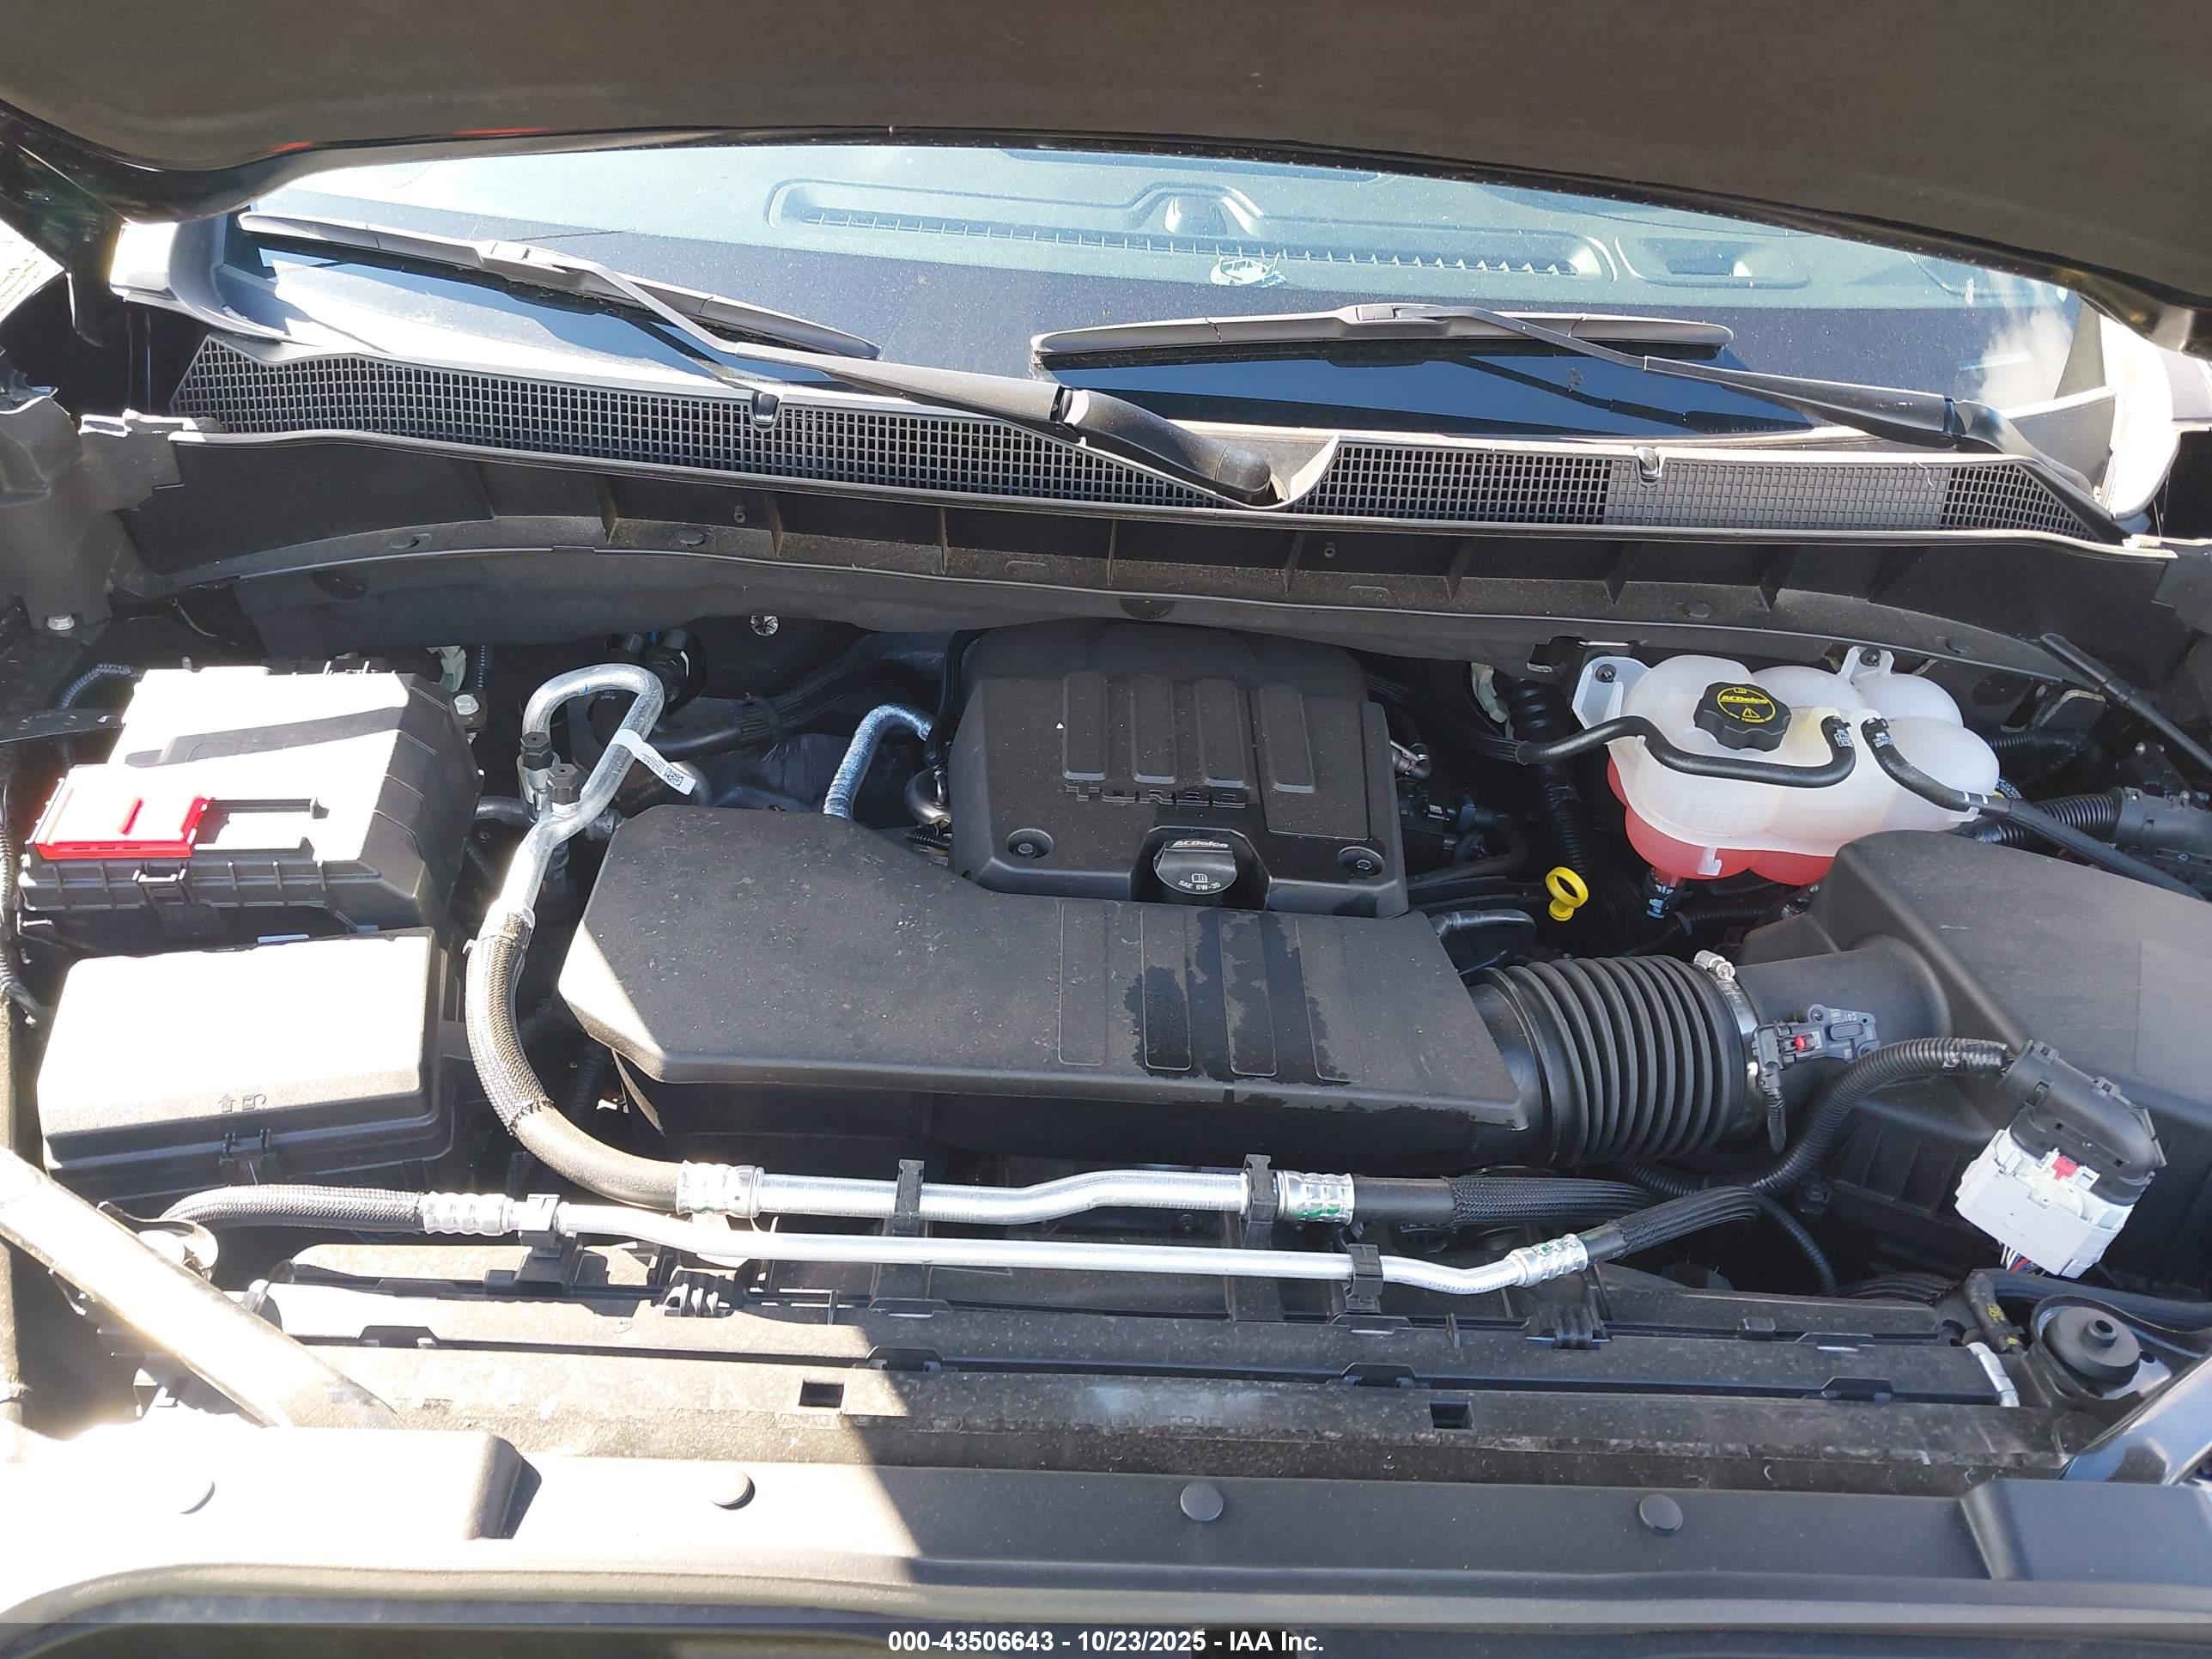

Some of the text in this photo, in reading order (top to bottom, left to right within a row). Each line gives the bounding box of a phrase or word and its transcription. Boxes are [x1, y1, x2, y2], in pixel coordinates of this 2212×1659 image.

[1719, 695, 1769, 704] ACDelco
[1170, 840, 1229, 848] ACDelco
[1178, 880, 1194, 890] SAE
